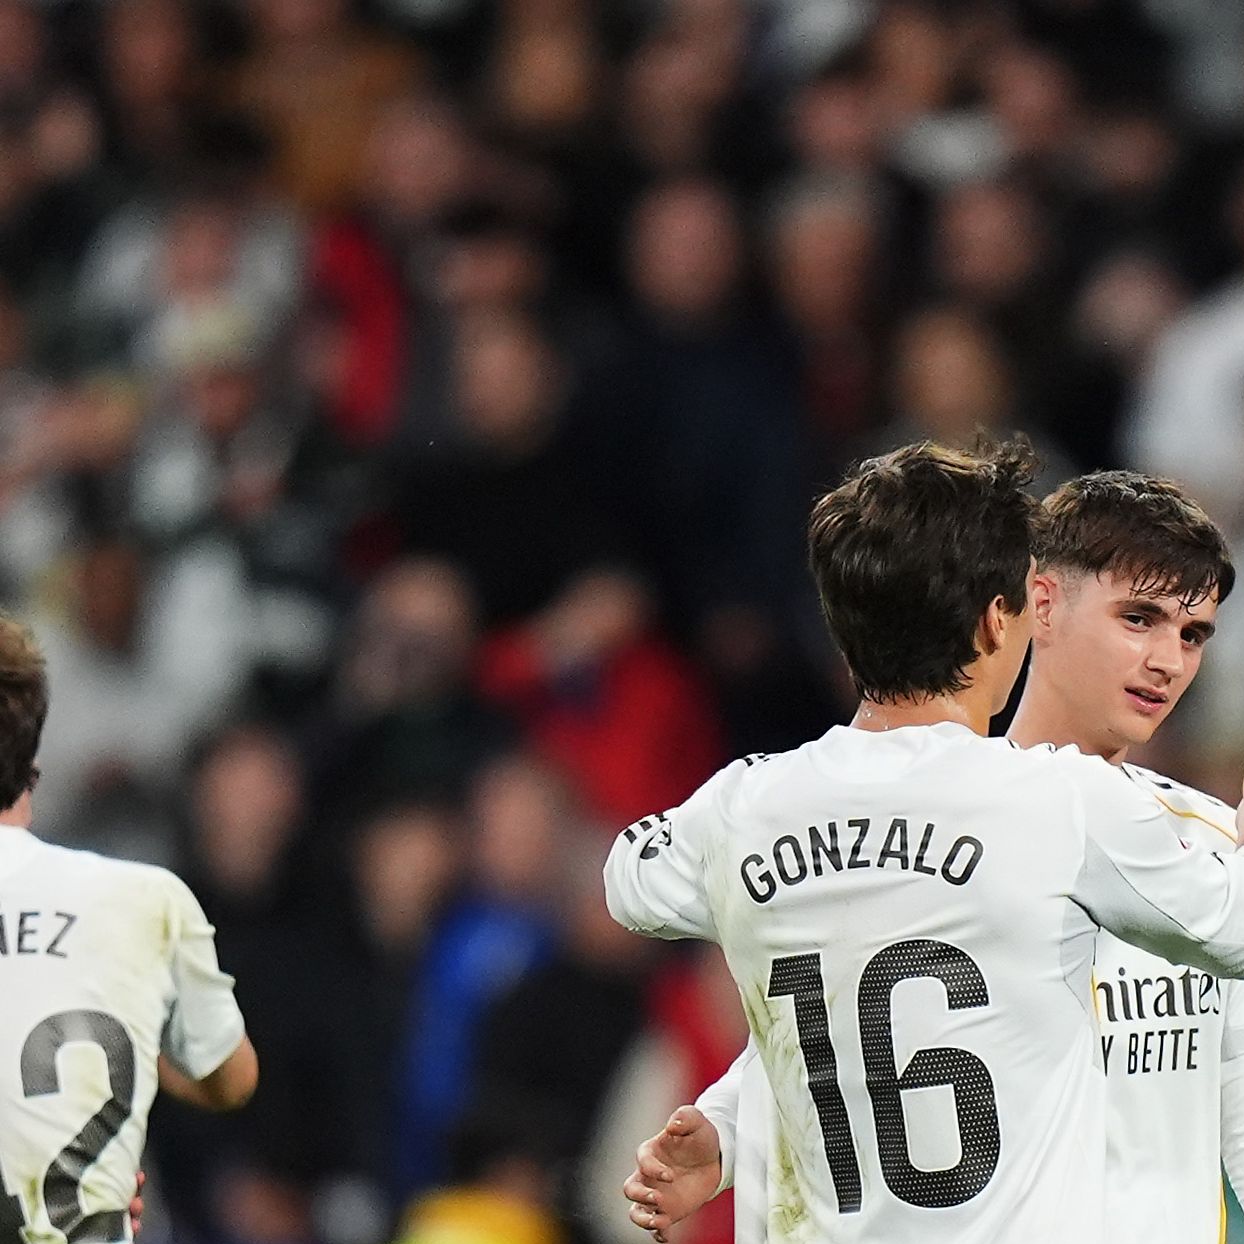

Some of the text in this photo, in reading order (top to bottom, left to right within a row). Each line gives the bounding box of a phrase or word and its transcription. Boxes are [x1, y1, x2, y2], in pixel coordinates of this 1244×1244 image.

[740, 817, 984, 904] GONZALO
[767, 938, 1002, 1215] 16
[1127, 1028, 1199, 1075] BETTE
